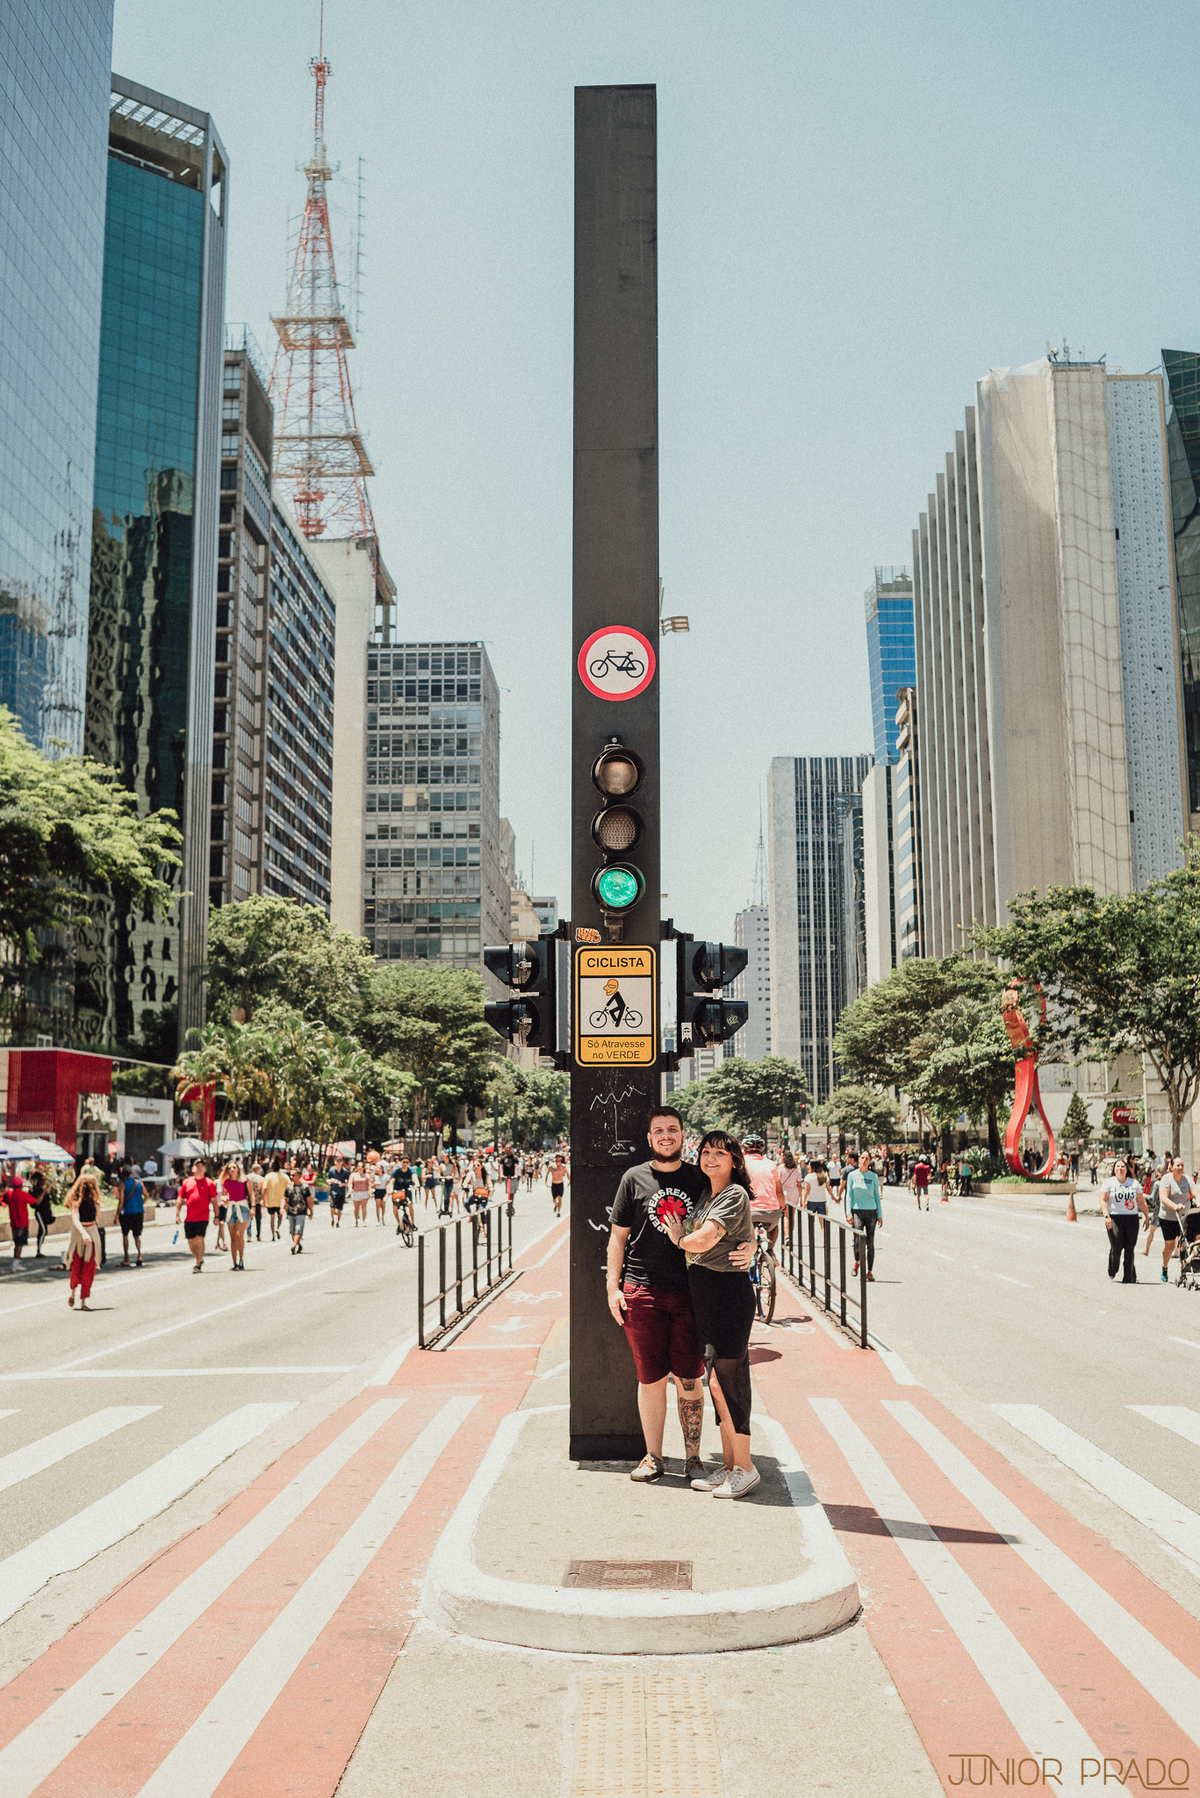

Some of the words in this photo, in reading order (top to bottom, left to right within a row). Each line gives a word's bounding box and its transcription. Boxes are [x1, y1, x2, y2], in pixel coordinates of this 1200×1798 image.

[587, 957, 644, 968] CICLISTA
[587, 1039, 600, 1048] Só
[601, 1039, 645, 1048] Atravesse
[606, 1050, 640, 1059] VERDE
[665, 1187, 688, 1200] RED
